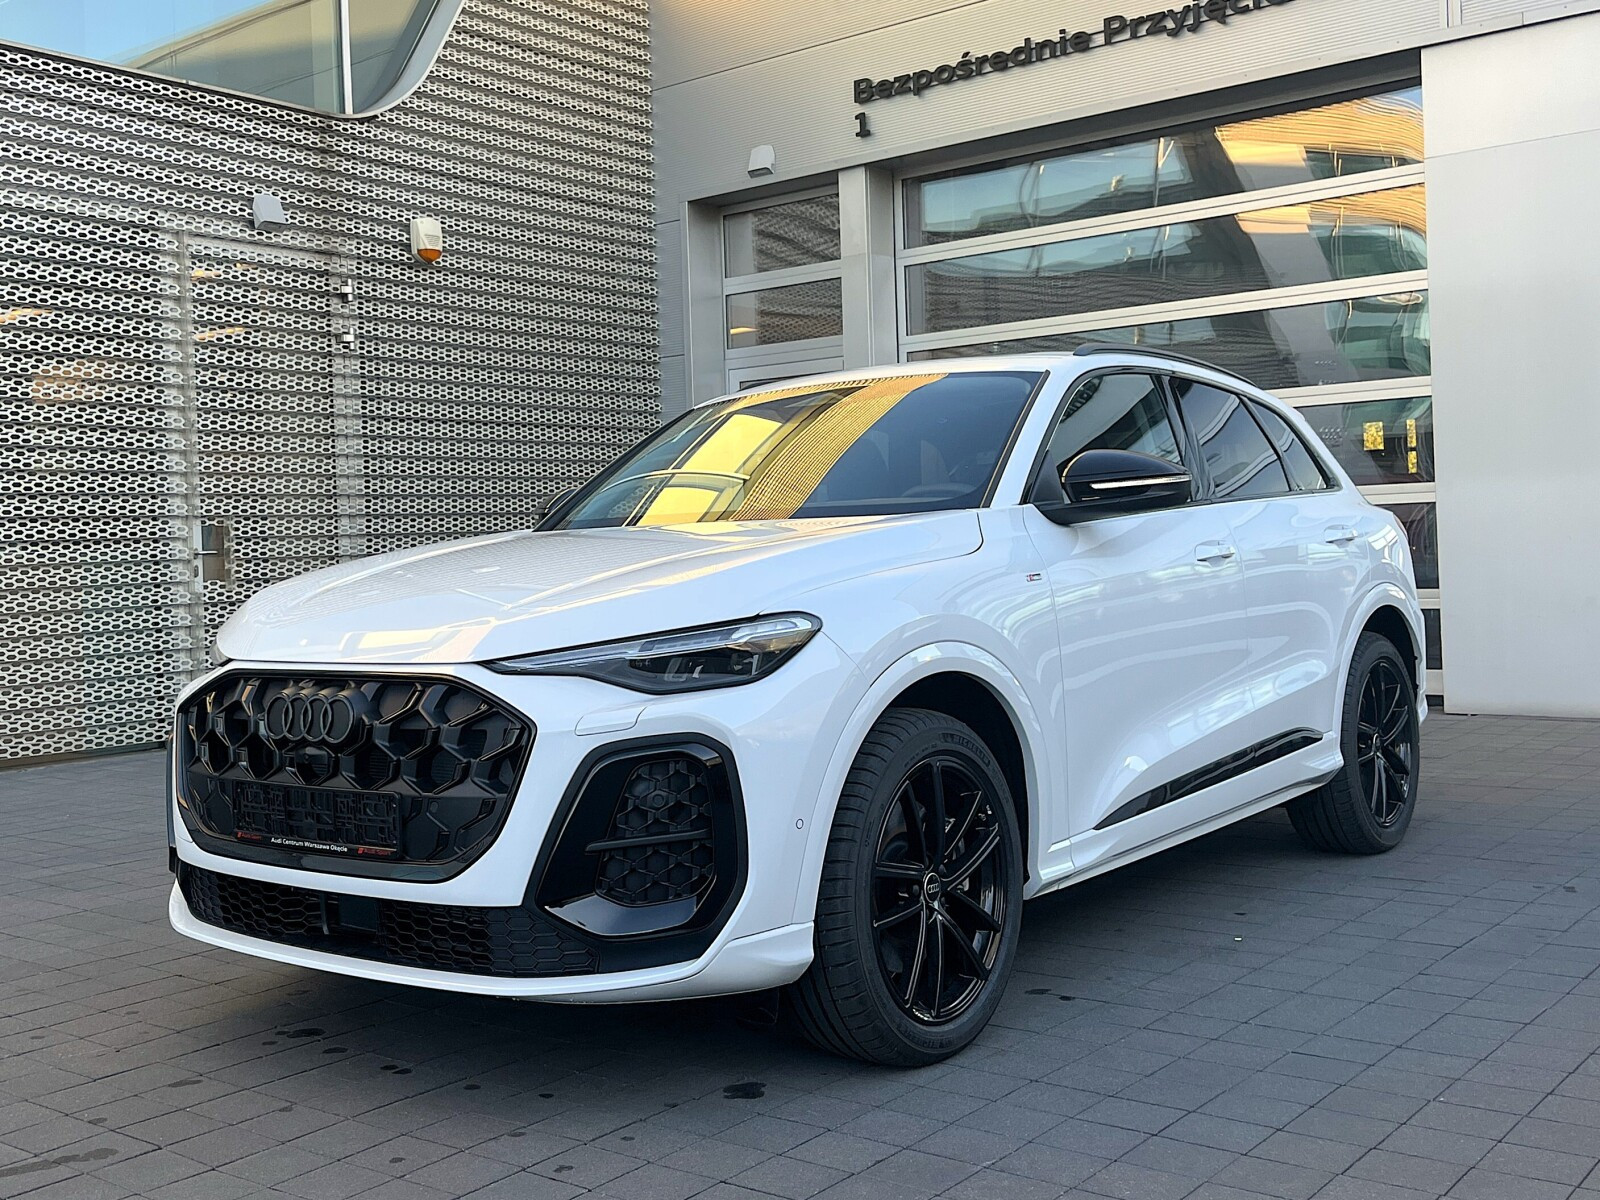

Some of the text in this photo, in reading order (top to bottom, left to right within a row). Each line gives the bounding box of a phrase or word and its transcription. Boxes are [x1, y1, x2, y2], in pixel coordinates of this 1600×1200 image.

[853, 0, 1287, 104] Bezpośrednie Przyjęc
[854, 112, 871, 138] 1
[283, 838, 303, 847] Centrum
